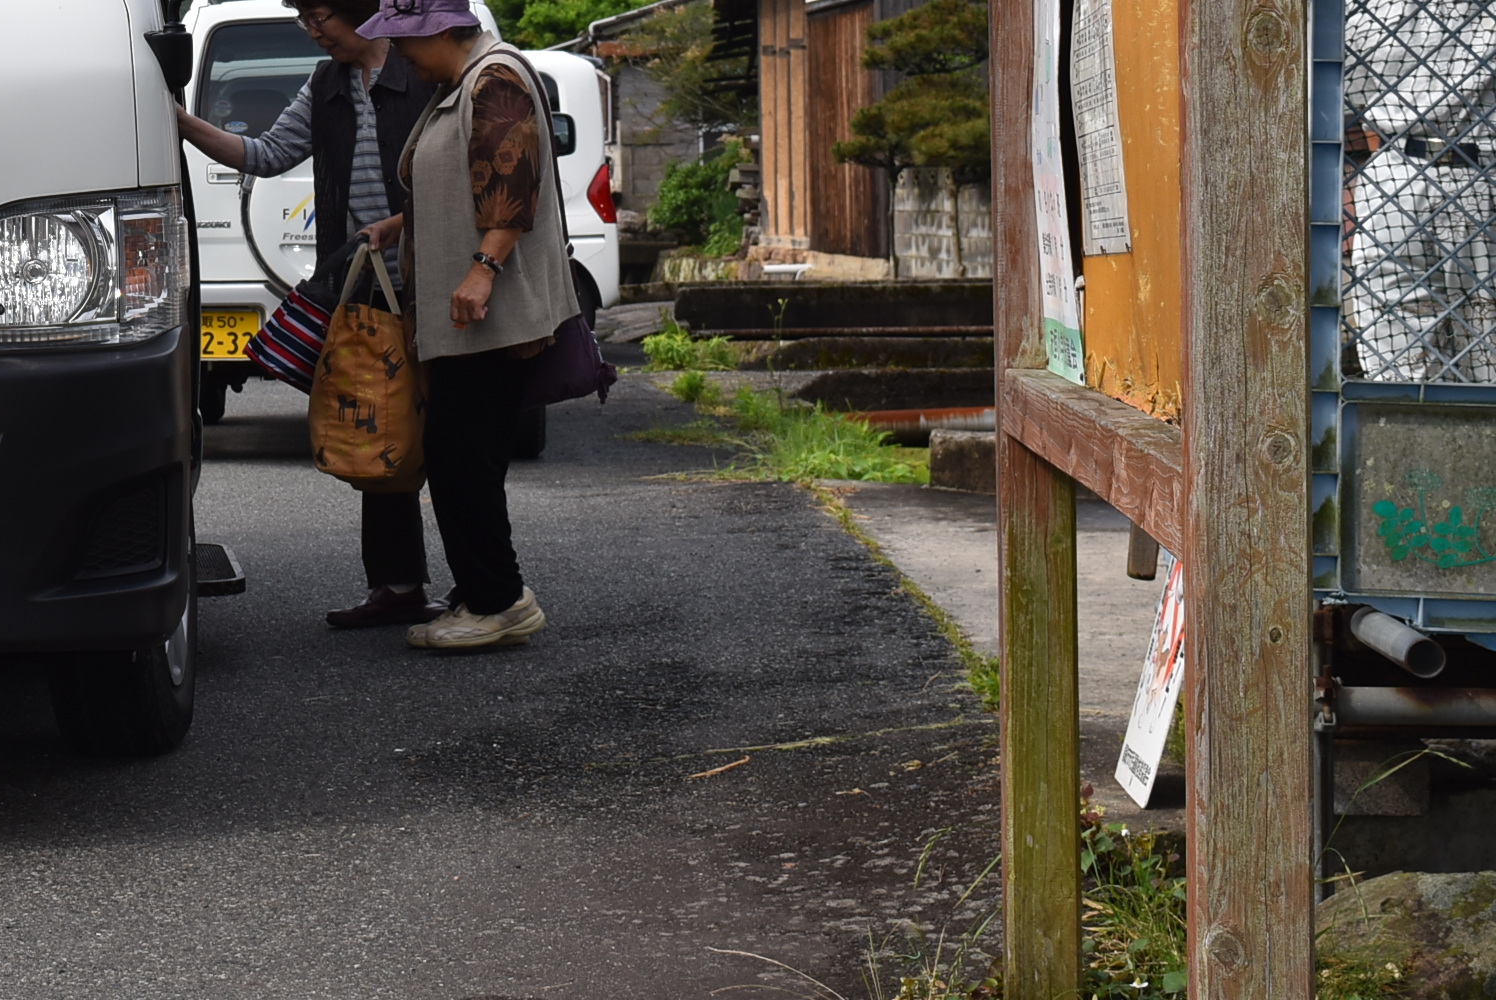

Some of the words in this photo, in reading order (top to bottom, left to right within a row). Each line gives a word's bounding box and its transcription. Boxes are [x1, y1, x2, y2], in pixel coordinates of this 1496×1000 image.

[282, 208, 307, 221] FI
[282, 232, 317, 241] Frees
[201, 315, 237, 329] 取50
[202, 331, 254, 355] 2-32
